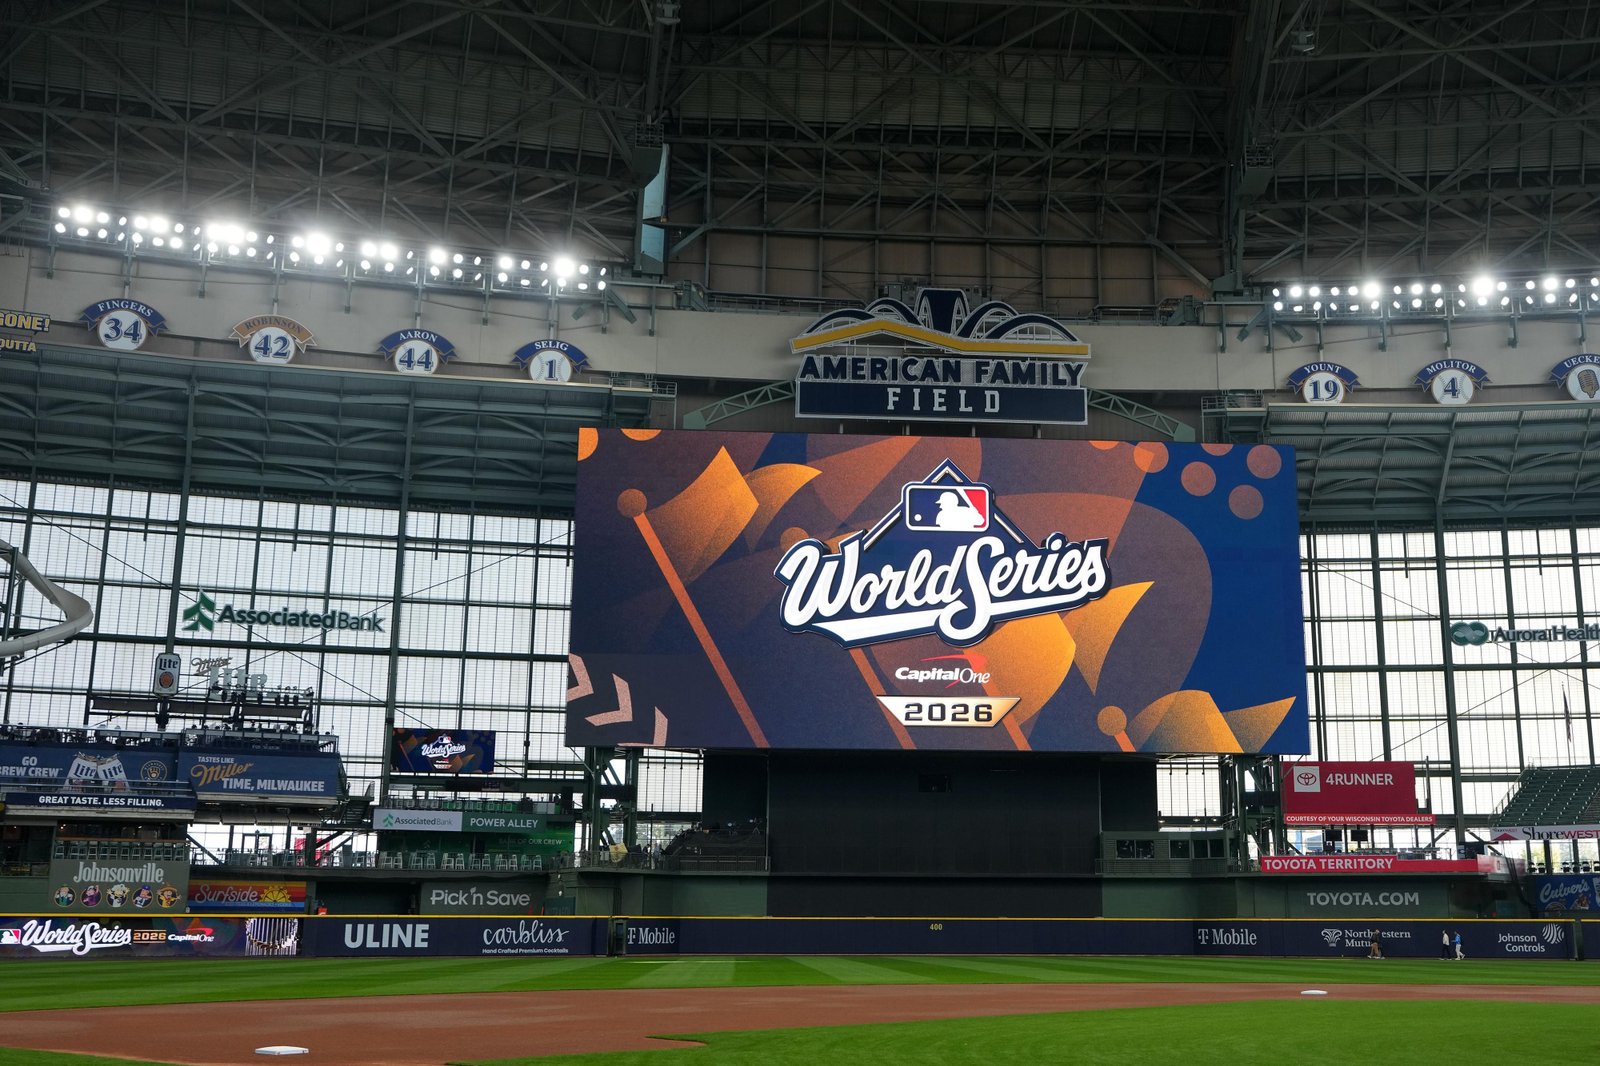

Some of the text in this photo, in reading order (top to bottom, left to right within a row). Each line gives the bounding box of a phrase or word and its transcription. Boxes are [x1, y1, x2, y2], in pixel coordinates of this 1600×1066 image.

[98, 300, 153, 317] FINGERS
[104, 317, 142, 343] 34
[245, 316, 302, 334] ROBINSON
[399, 330, 438, 343] AARON
[254, 335, 291, 358] 42
[534, 340, 569, 351] SELIG
[399, 348, 433, 371] 44
[1564, 355, 1600, 369] UECKE
[545, 358, 558, 381] 1
[800, 355, 1084, 387] AMERICAN FAMILY
[1303, 364, 1342, 374] YOUNT
[1426, 360, 1476, 375] MOLITOR
[1309, 379, 1340, 401] 19
[1443, 377, 1461, 398] 4
[887, 387, 1000, 413] FIELD
[780, 536, 1106, 640] World Series
[1494, 626, 1547, 641] Aurora
[159, 658, 179, 670] Lite
[904, 703, 993, 721] 2026
[22, 756, 37, 766] GO
[0, 766, 26, 776] REW
[74, 763, 97, 777] Lite
[190, 763, 254, 787] Miller
[222, 778, 325, 792] TIME, MILWAUKEE
[1325, 773, 1393, 786] 4RUNNER
[39, 796, 164, 806] GREAT TASTE. LESS FILLING.
[470, 817, 538, 828] POWER ALLEY
[1265, 858, 1393, 870] TOYOTA TERRITORY
[73, 862, 164, 883] Johnsonville
[195, 884, 259, 904] Surfside
[430, 890, 468, 905] Pick
[486, 890, 530, 906] Save
[1540, 879, 1590, 903] Culver's
[1307, 892, 1419, 906] TOYOTA.COM
[21, 919, 132, 955] World Series
[133, 932, 166, 940] 2026
[344, 923, 430, 949] ULINE
[483, 920, 570, 945] carbliss
[1344, 929, 1411, 938] Northestern
[1498, 933, 1537, 943] Johnson
[1345, 939, 1371, 947] Mutu
[1505, 943, 1545, 952] Controls
